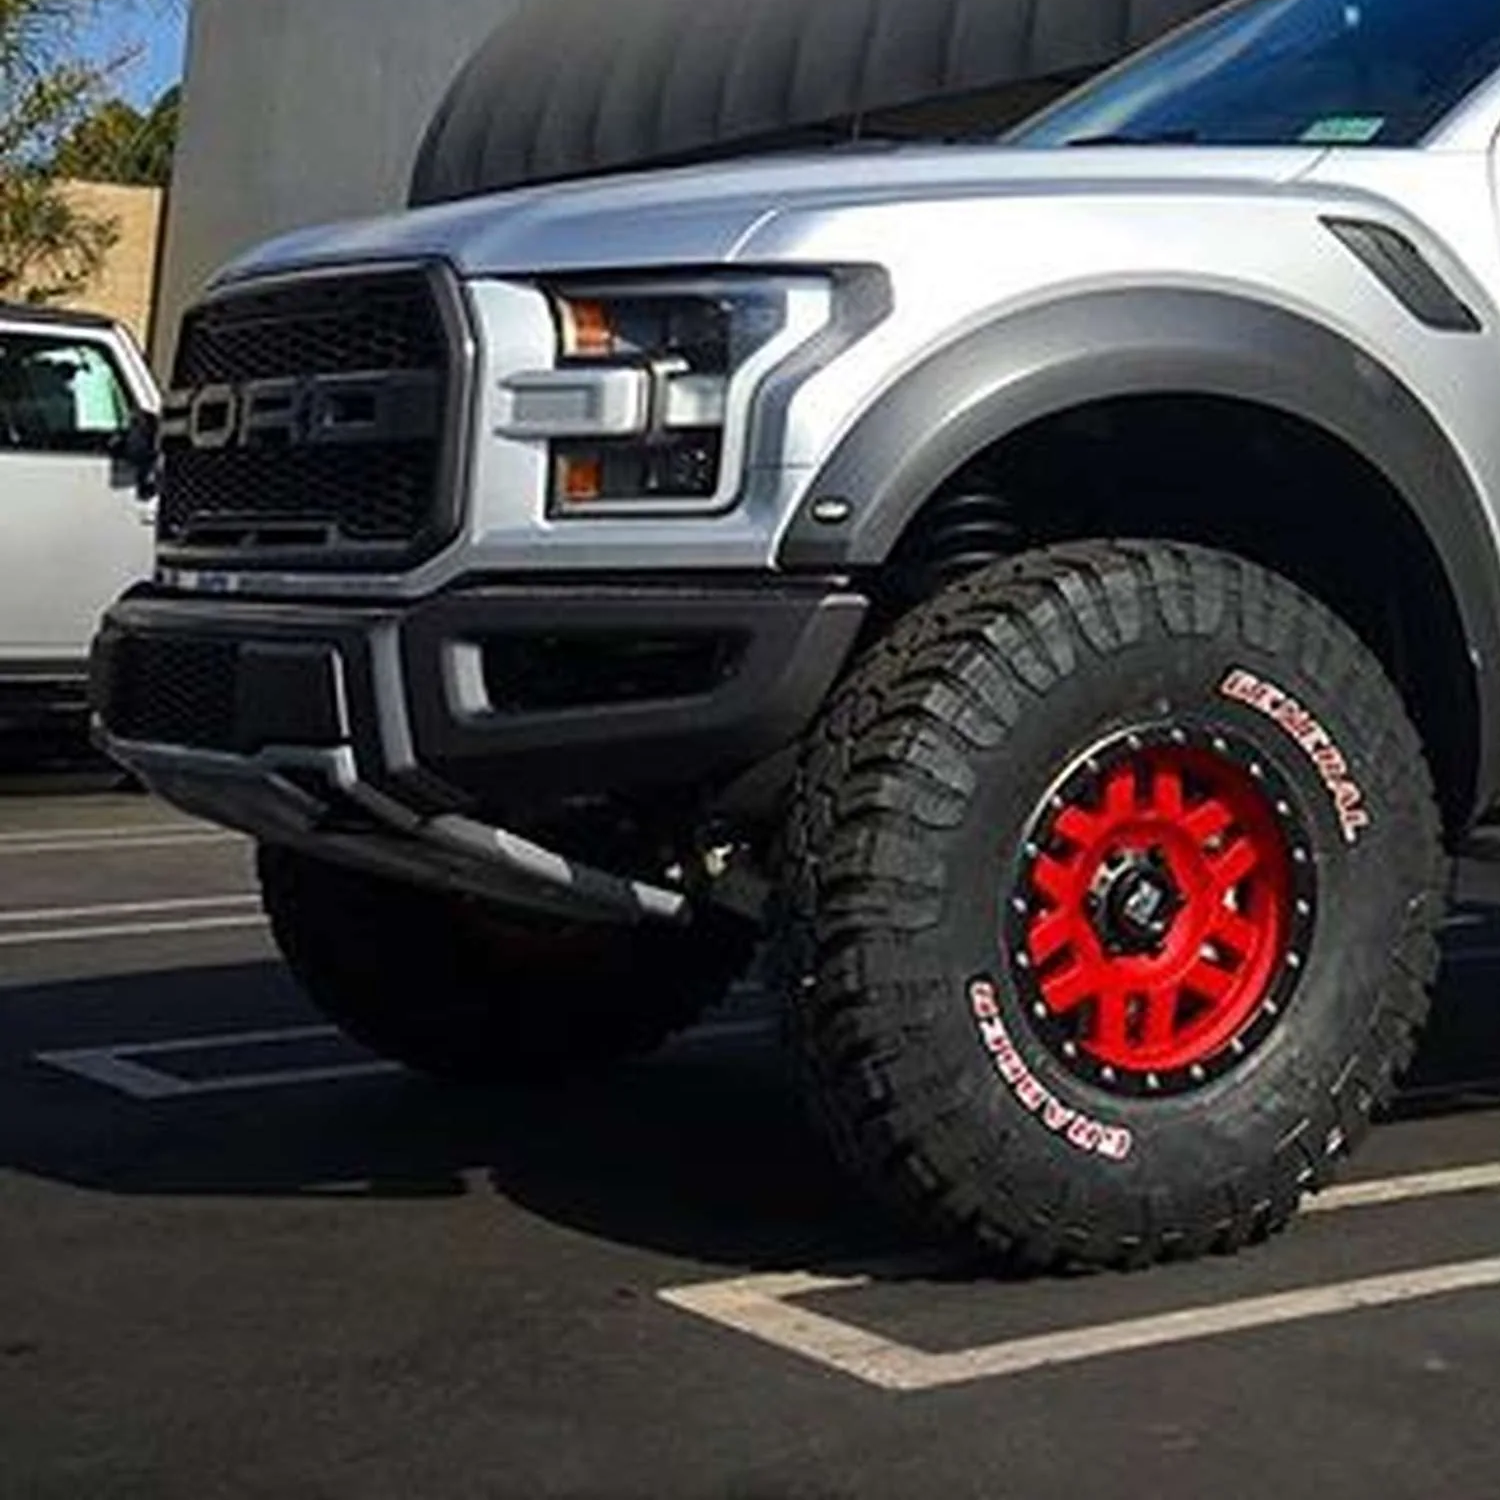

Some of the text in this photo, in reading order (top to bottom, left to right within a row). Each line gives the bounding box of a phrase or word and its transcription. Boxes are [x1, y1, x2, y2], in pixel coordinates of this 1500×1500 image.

[154, 368, 388, 449] FORD
[1220, 668, 1370, 842] GENERAL
[969, 980, 1132, 1160] GRABBER
